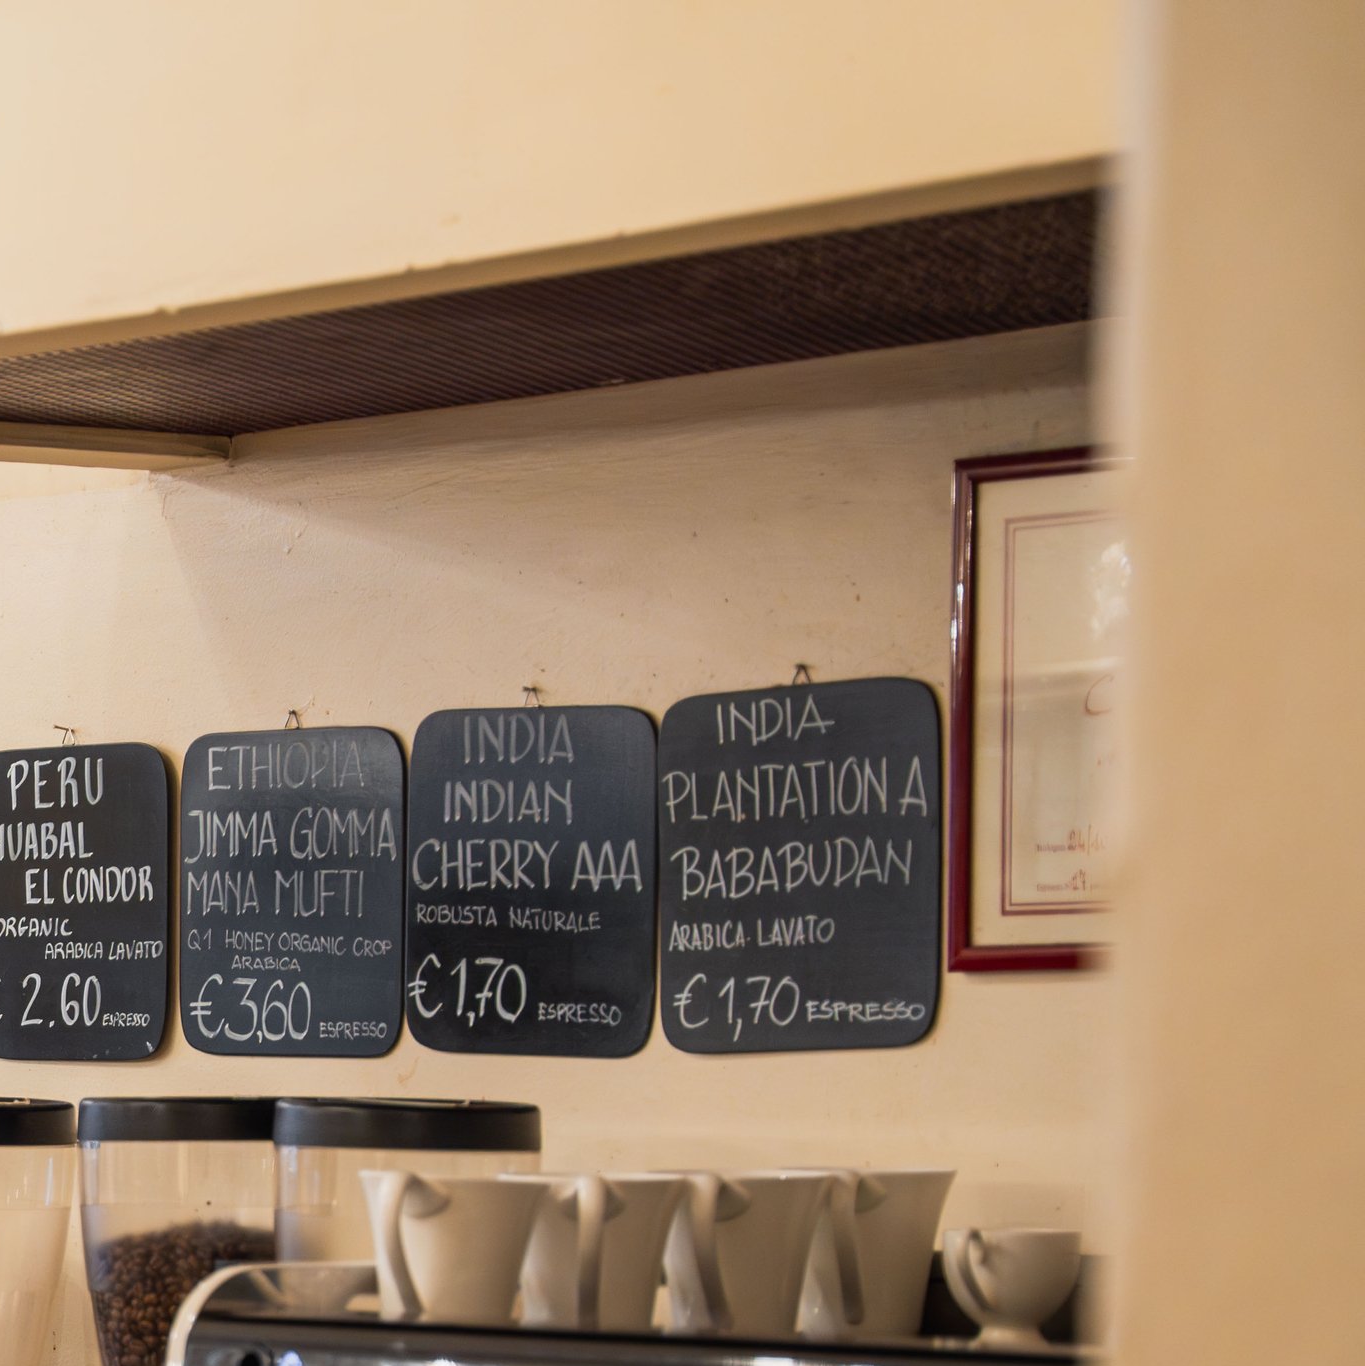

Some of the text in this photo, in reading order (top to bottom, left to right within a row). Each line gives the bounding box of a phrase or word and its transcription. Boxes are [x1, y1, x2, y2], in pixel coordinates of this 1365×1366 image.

[464, 713, 574, 765] INDIA
[717, 694, 835, 746] INDIA
[7, 756, 103, 811] PERU
[208, 741, 365, 791] ETHIOPIA
[445, 779, 572, 824] INDIAN
[662, 755, 927, 823] PLANTATION A
[185, 807, 397, 863] JIMMA GOMMA
[25, 865, 153, 904] EL CONDOR
[412, 838, 643, 892] CHERRY AAA
[670, 836, 912, 900] BABABUDAN
[187, 870, 364, 918] MANA MUFTI
[417, 904, 601, 933] ROBUSTA NATURALE
[757, 915, 835, 947] LAVATO
[45, 940, 164, 960] ARABICA LAVATO
[188, 929, 392, 957] Q1 HONEY ORGANIC CROP
[232, 956, 301, 972] ARABICA
[102, 1012, 150, 1027] ESPRESSO
[319, 1021, 387, 1040] ESPRESSO
[538, 1002, 621, 1026] ESPRESSO
[806, 1000, 926, 1022] ESPRESSO
